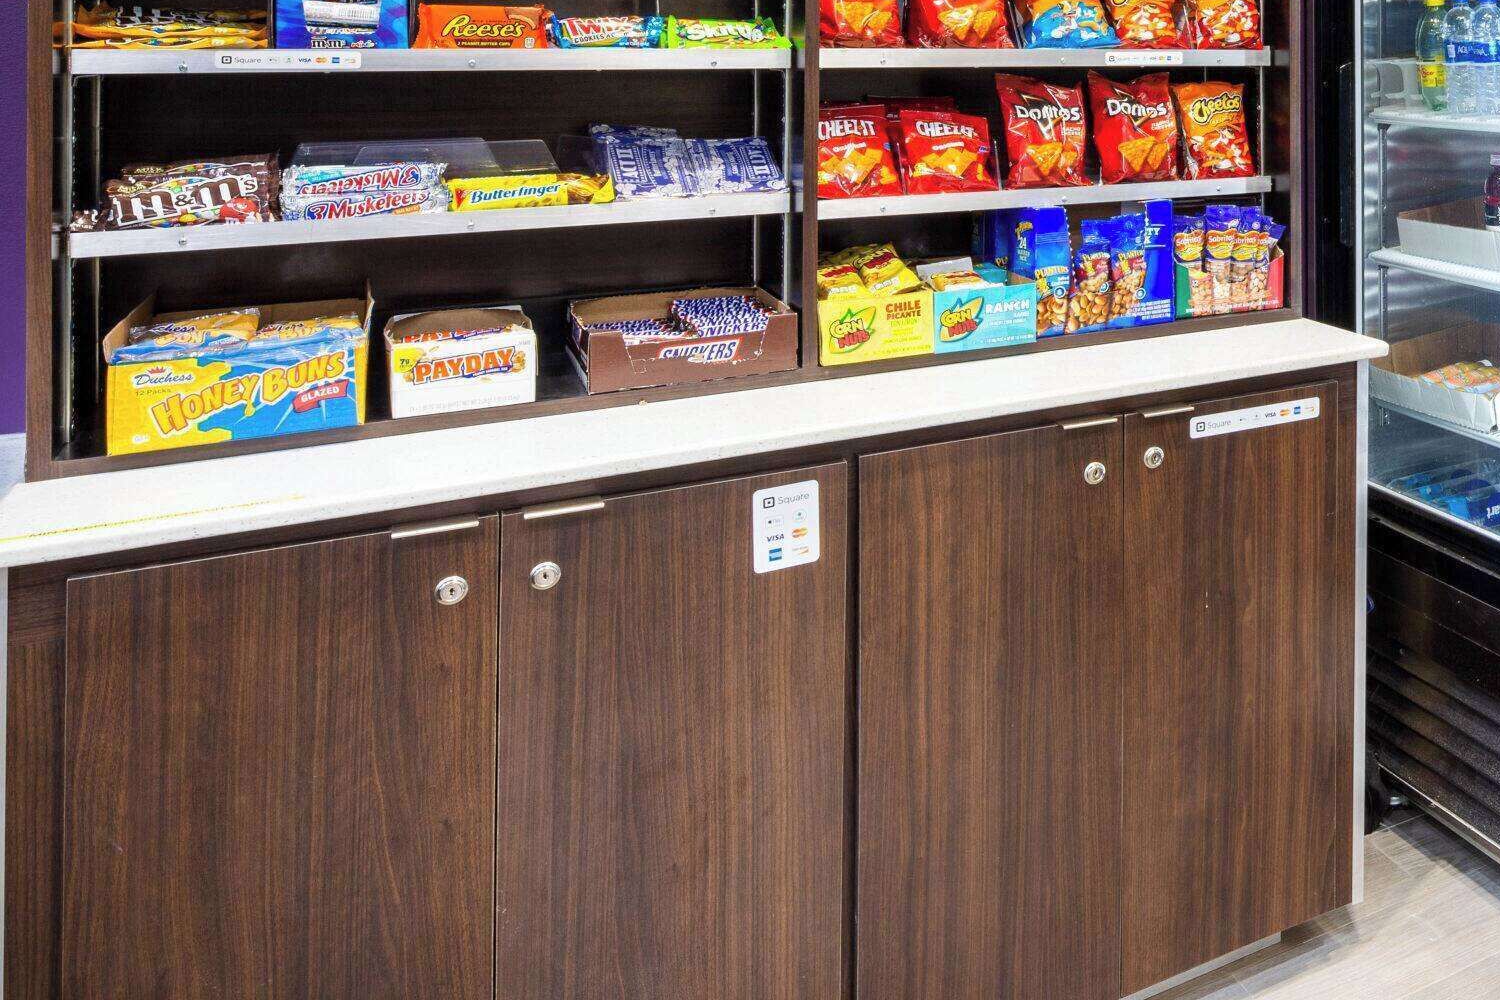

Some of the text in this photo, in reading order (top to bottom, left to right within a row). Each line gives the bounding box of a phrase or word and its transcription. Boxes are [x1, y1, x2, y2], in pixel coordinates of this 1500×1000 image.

[441, 14, 526, 37] Reese's
[234, 55, 262, 65] Square
[1106, 98, 1171, 117] Doritos
[1191, 93, 1242, 123] Cheetos
[470, 181, 561, 204] Butterfinger
[328, 191, 430, 220] Musketeers
[885, 300, 922, 314] CHILE
[985, 299, 1030, 315] RANCH
[940, 309, 973, 327] CORN
[829, 317, 864, 338] CORN
[414, 347, 515, 384] PAYDAY
[136, 372, 194, 387] Duchess
[152, 351, 346, 435] HONEY BUNS
[301, 385, 340, 402] GLAZED
[1207, 419, 1232, 430] Square
[777, 491, 810, 505] Square
[766, 533, 784, 542] VISA
